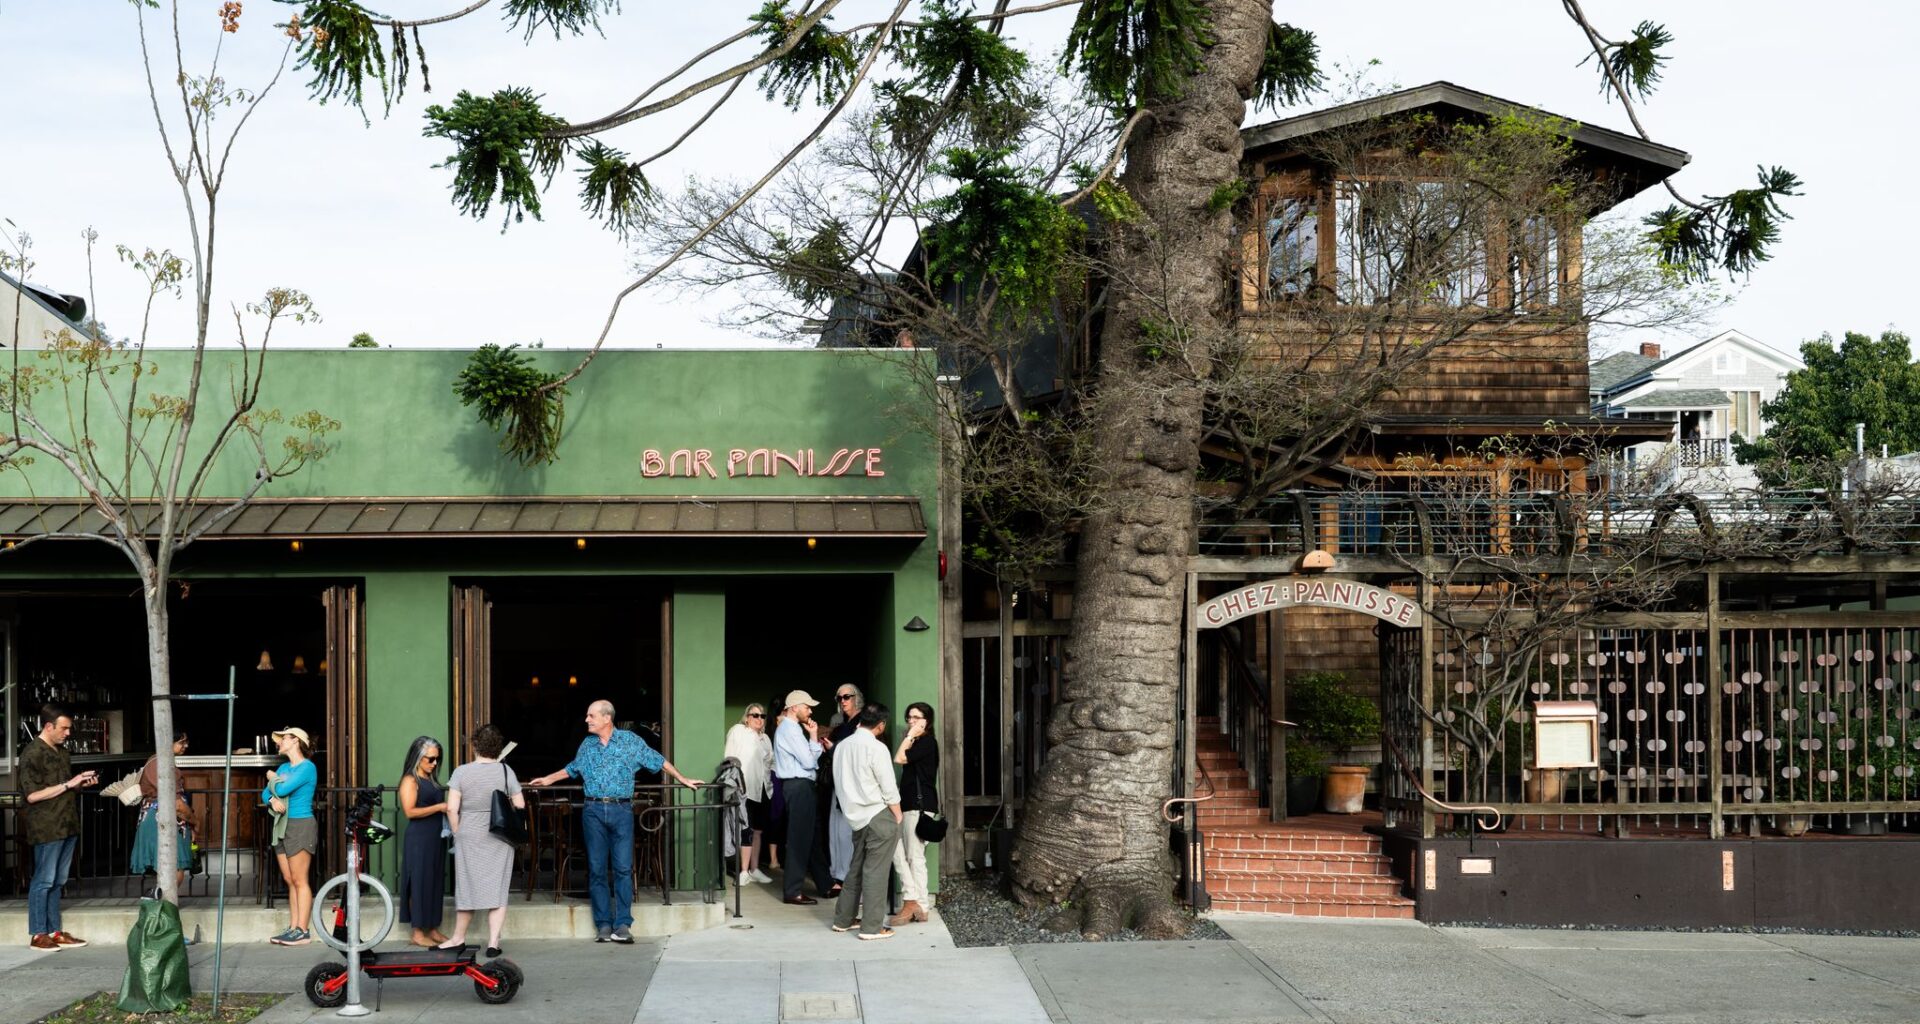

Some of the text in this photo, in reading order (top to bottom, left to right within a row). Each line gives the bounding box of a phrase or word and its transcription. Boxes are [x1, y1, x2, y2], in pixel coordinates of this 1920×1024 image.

[641, 448, 885, 478] BAR PANISSE
[1205, 584, 1278, 625] CHEZ
[1294, 581, 1415, 626] PANISSE
